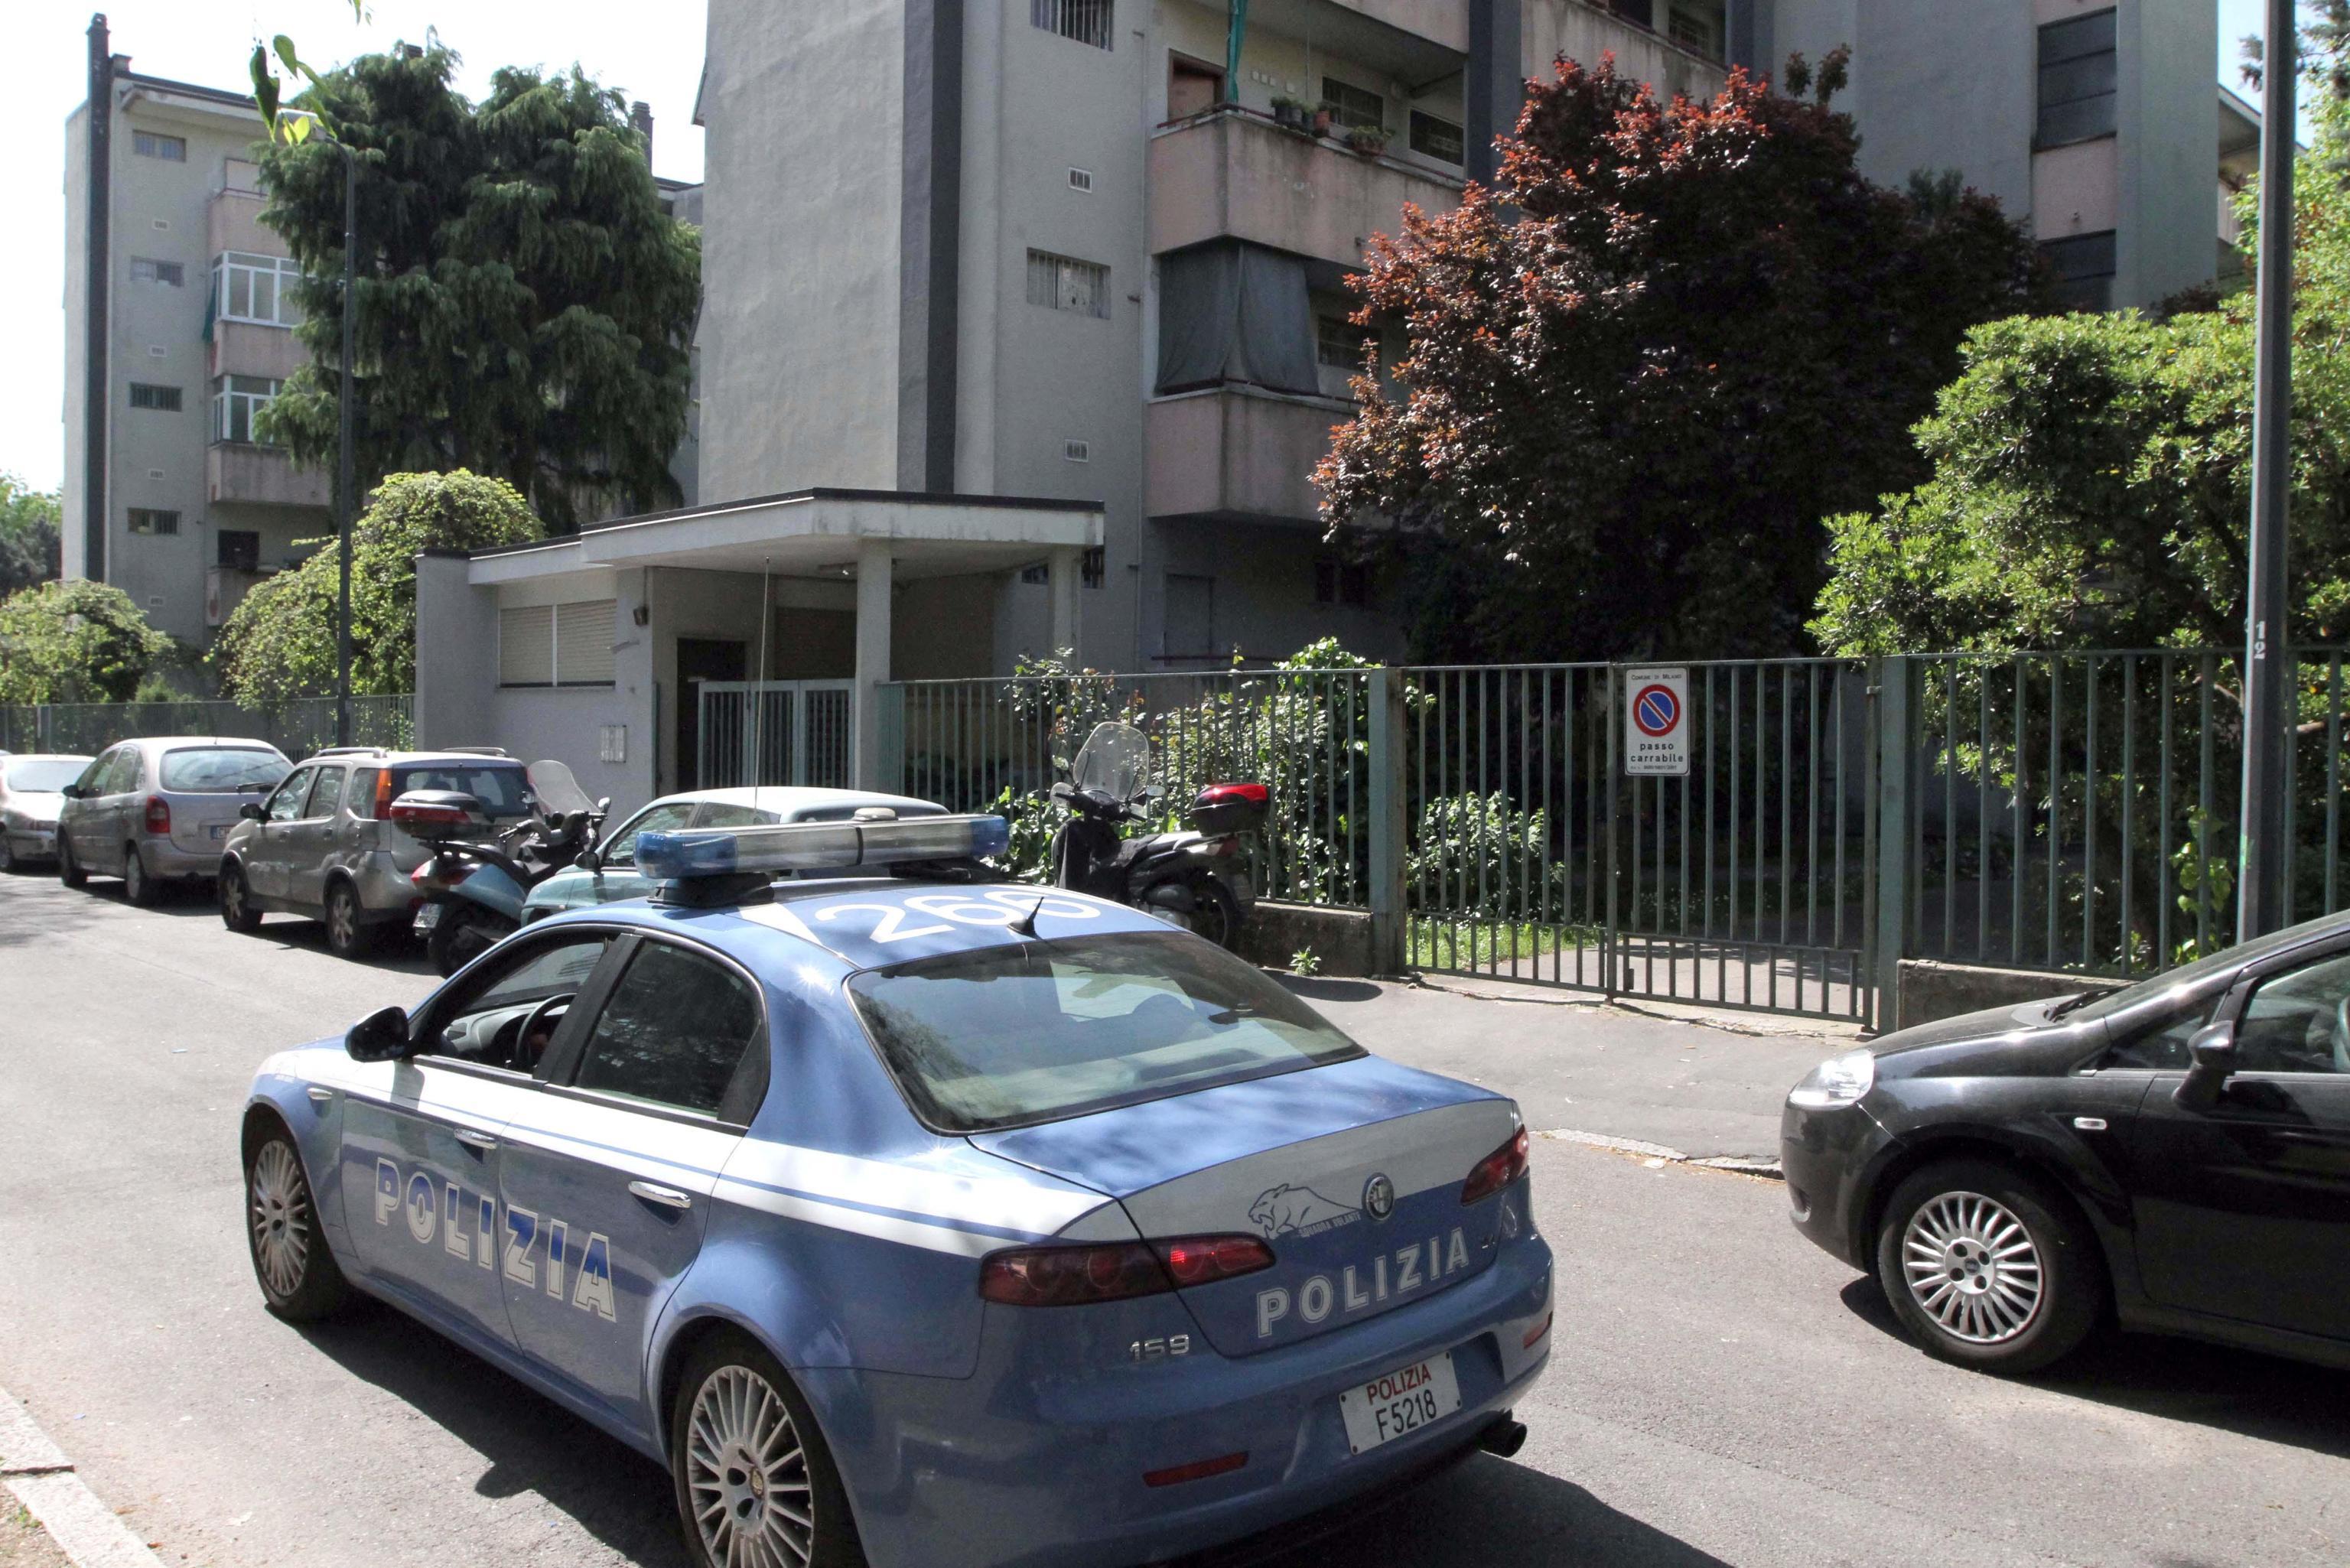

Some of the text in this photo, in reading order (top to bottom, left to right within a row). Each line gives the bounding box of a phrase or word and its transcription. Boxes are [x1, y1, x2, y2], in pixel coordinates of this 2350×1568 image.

[1630, 753, 1683, 762] carrabile
[1640, 743, 1674, 751] passo
[815, 890, 1101, 943] 266
[376, 1156, 617, 1322] POLIZIA
[1257, 1228, 1469, 1339] POLIZIA
[1129, 1334, 1190, 1364] 159
[1365, 1364, 1432, 1406] POLIZIA
[1376, 1389, 1437, 1441] F5218
